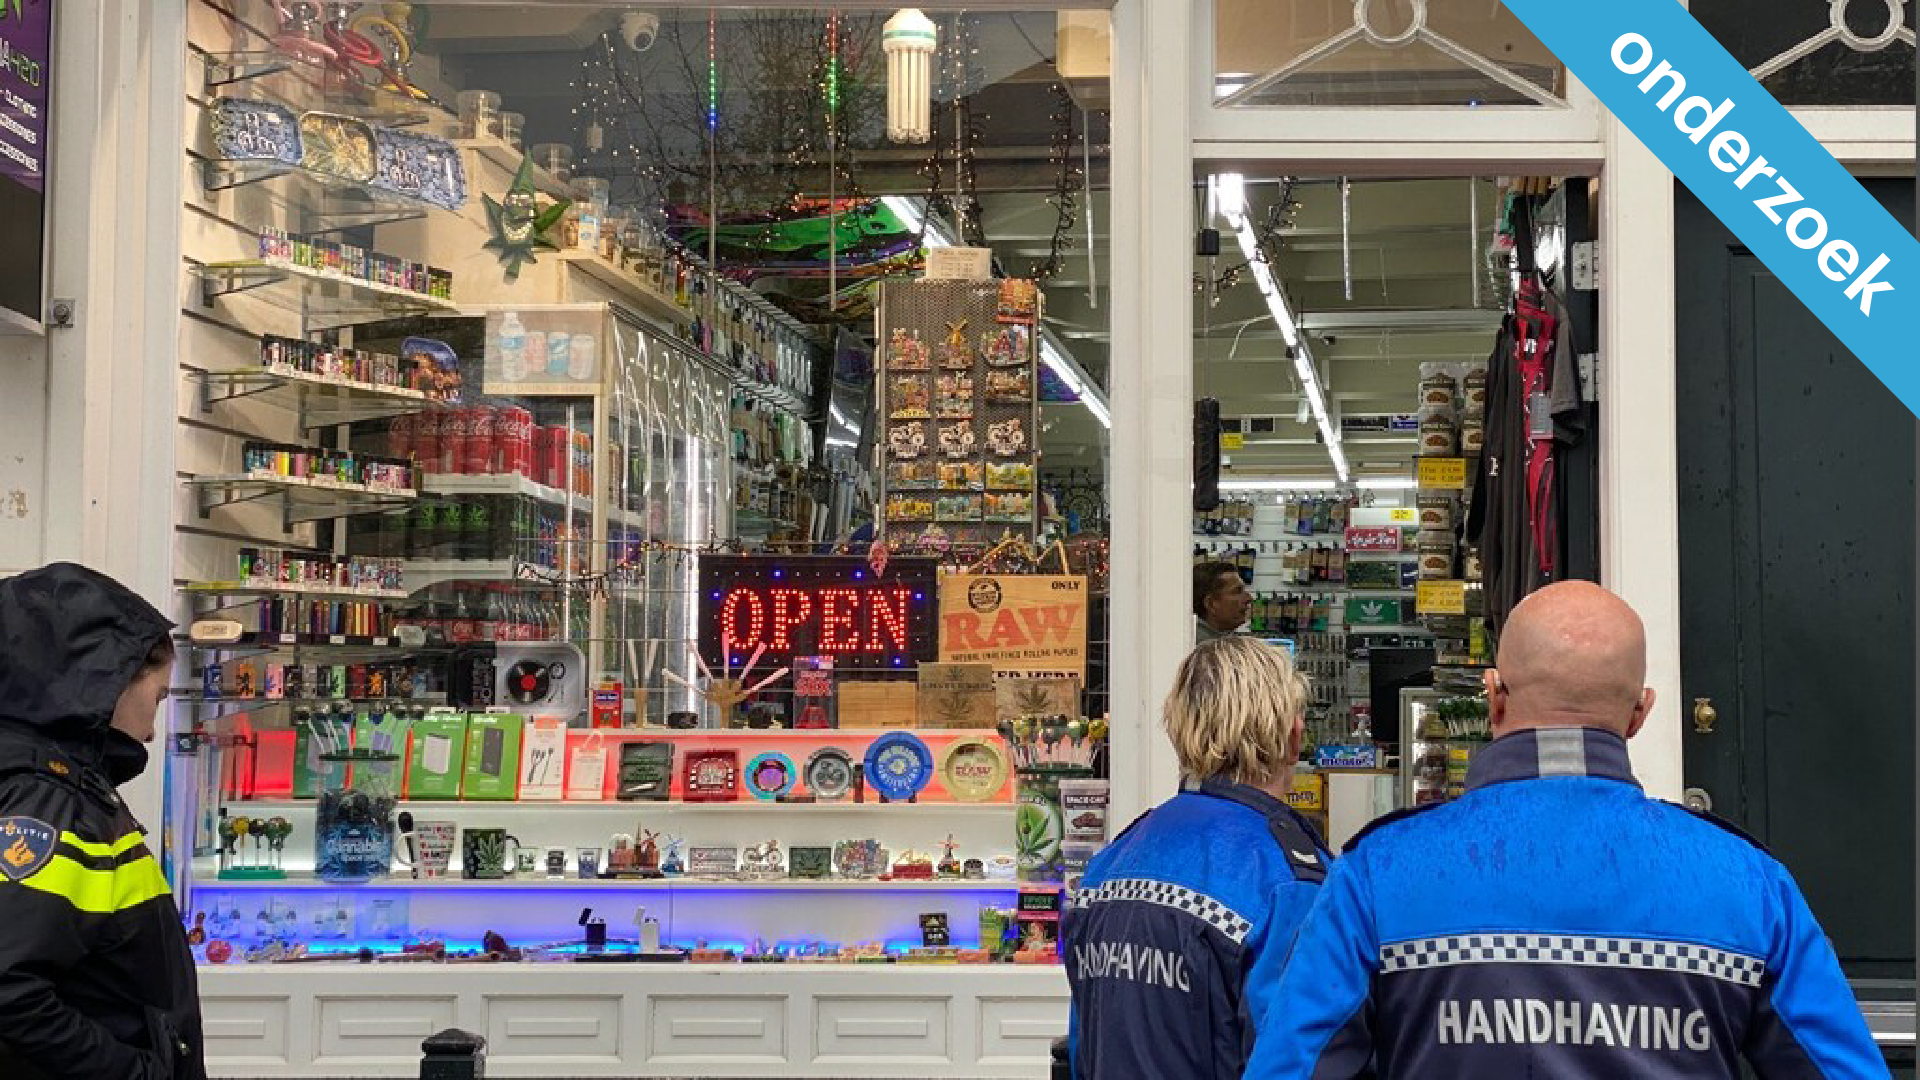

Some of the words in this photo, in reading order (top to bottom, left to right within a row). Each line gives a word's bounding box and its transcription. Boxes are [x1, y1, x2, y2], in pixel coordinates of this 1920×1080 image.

[1051, 581, 1080, 590] ONLY
[721, 588, 912, 650] OPEN
[943, 604, 1081, 651] RAW
[1439, 999, 1711, 1051] HANDHAVING
